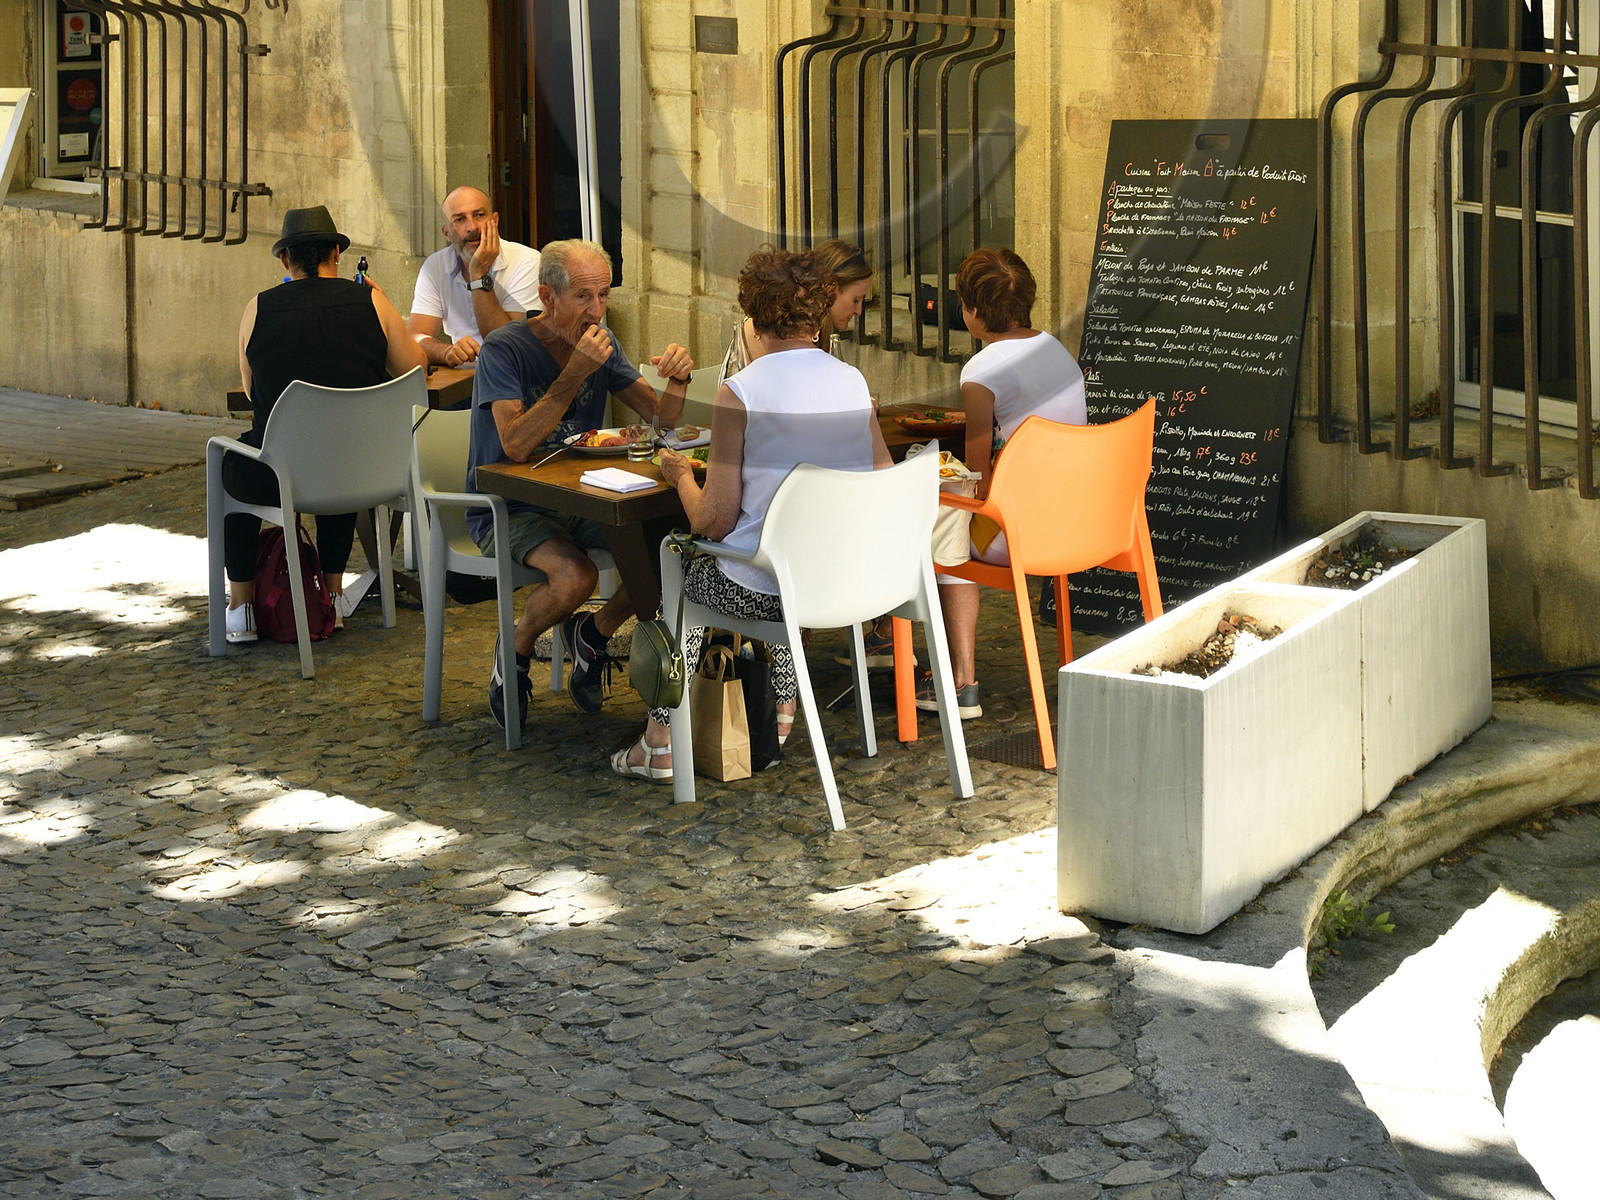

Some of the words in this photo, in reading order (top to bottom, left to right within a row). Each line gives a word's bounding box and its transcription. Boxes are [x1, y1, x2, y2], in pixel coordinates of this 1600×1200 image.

[1124, 162, 1151, 176] Cuisine
[1173, 162, 1200, 176] Maison
[1247, 166, 1260, 178] de
[1114, 184, 1143, 199] partager
[1095, 258, 1122, 275] MELON
[1137, 258, 1154, 274] Pays
[1156, 262, 1166, 272] et
[1169, 262, 1200, 274] JAMBON
[1201, 266, 1214, 276] de
[1215, 265, 1245, 277] PARME
[1086, 318, 1108, 330] Salade
[1136, 391, 1146, 400] de
[1101, 404, 1112, 414] et
[1212, 470, 1257, 486] CHAMPIGNONS
[1094, 585, 1125, 598] chocolat
[1073, 604, 1109, 618] GOURMAND
